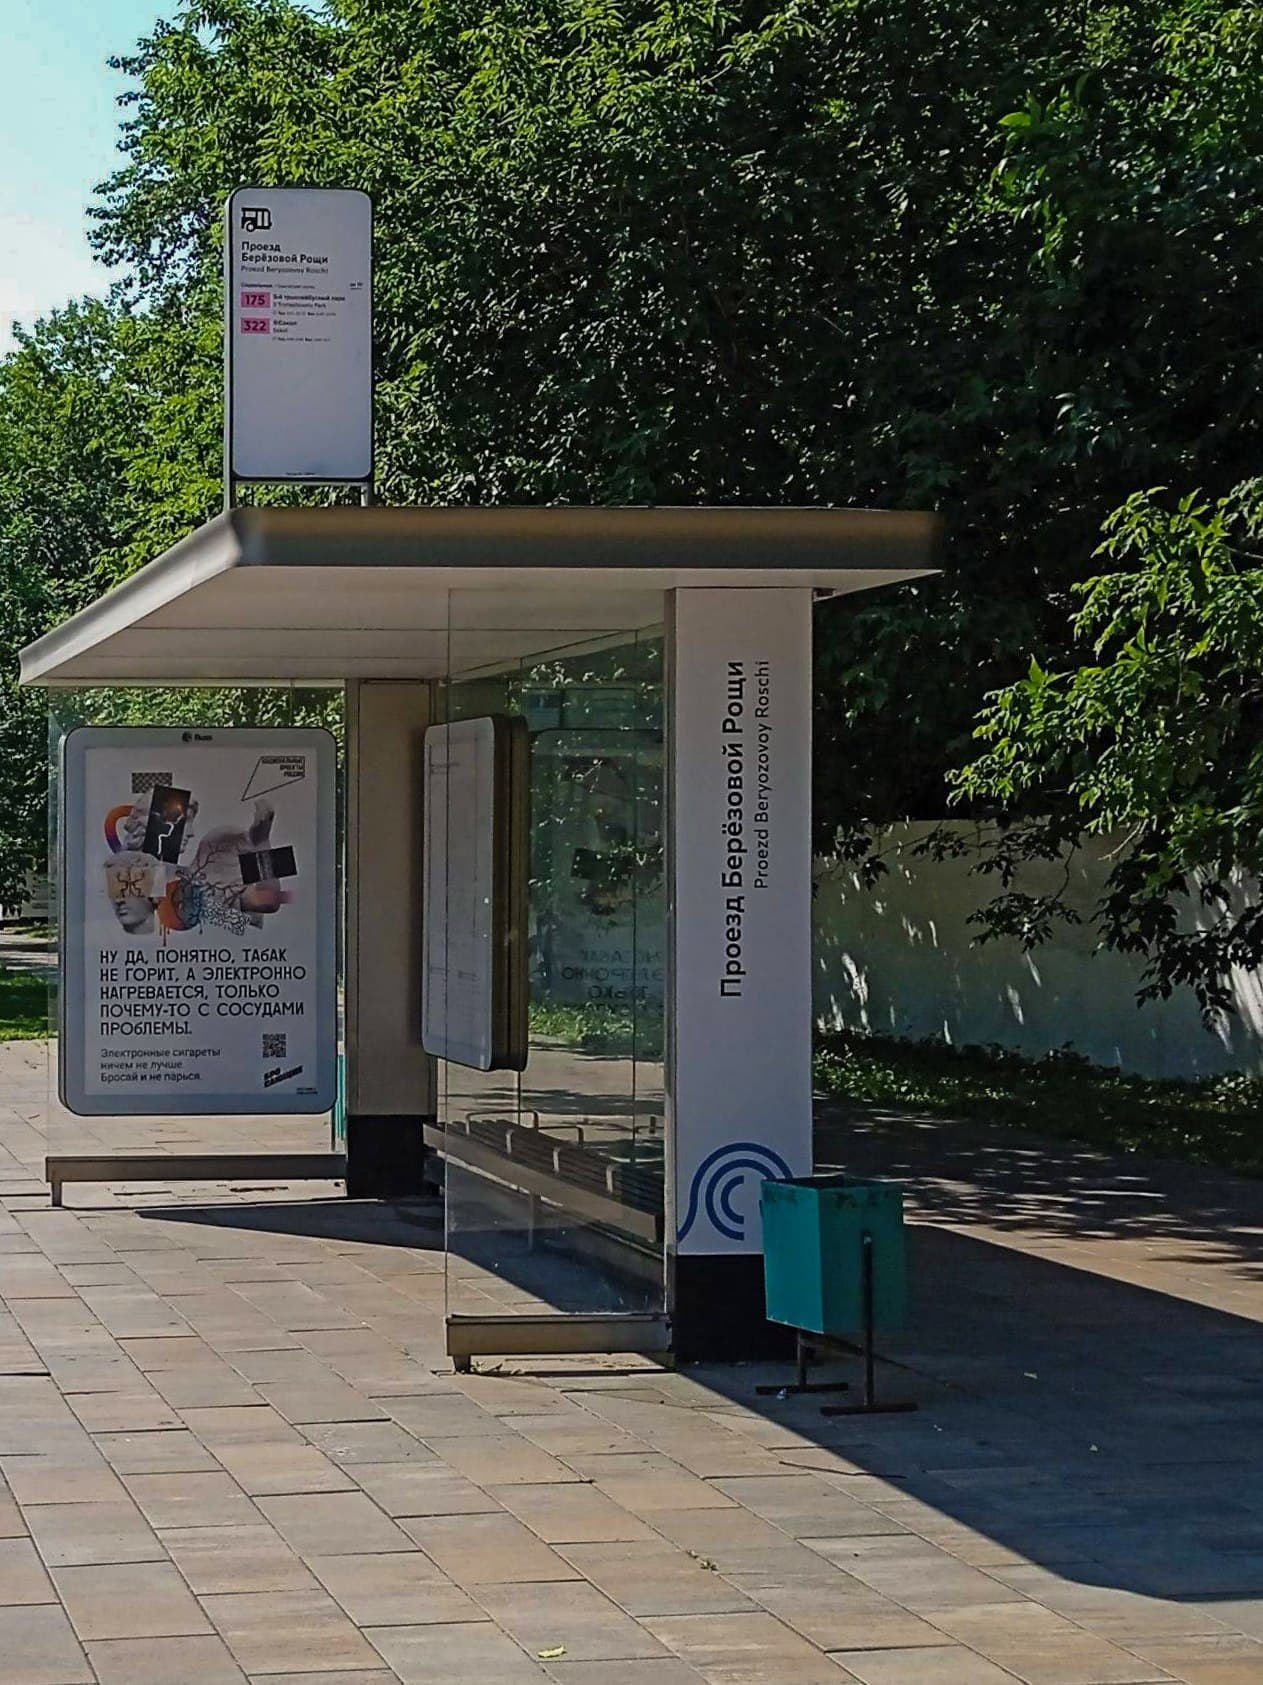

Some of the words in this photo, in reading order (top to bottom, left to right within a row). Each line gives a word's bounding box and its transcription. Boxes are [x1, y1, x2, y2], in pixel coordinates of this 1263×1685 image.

[241, 241, 281, 252] Проезд
[241, 252, 298, 264] Берёзовой
[300, 254, 329, 265] Рощи
[245, 294, 265, 305] 175
[244, 320, 267, 331] 322
[755, 661, 769, 717] Roschi
[722, 662, 746, 733] Рощи
[754, 723, 772, 822] Beryozovoy
[722, 743, 747, 887] Берёзовой
[754, 829, 769, 888] Proezd
[720, 896, 746, 997] Проезд
[100, 950, 117, 964] НУ
[125, 950, 148, 965] ДА,
[156, 949, 235, 964] ПОНЯТНО,
[100, 968, 118, 982] НЕ
[125, 967, 179, 983] ГОРИТ,
[186, 967, 196, 980] А
[202, 966, 306, 981] ЭЛЕКТРОННО
[100, 985, 208, 1000] НАГРЕВАЕТСЯ,
[216, 984, 280, 999] ТОЛЬКО
[100, 1003, 190, 1018] ПОЧЕМУ-ТО
[198, 1002, 210, 1016] С
[217, 1002, 304, 1018] СОСУДАМИ
[100, 1048, 170, 1059] Электронные
[172, 1048, 221, 1058] сигареты
[100, 1072, 138, 1084] Бросай
[149, 1073, 162, 1081] не
